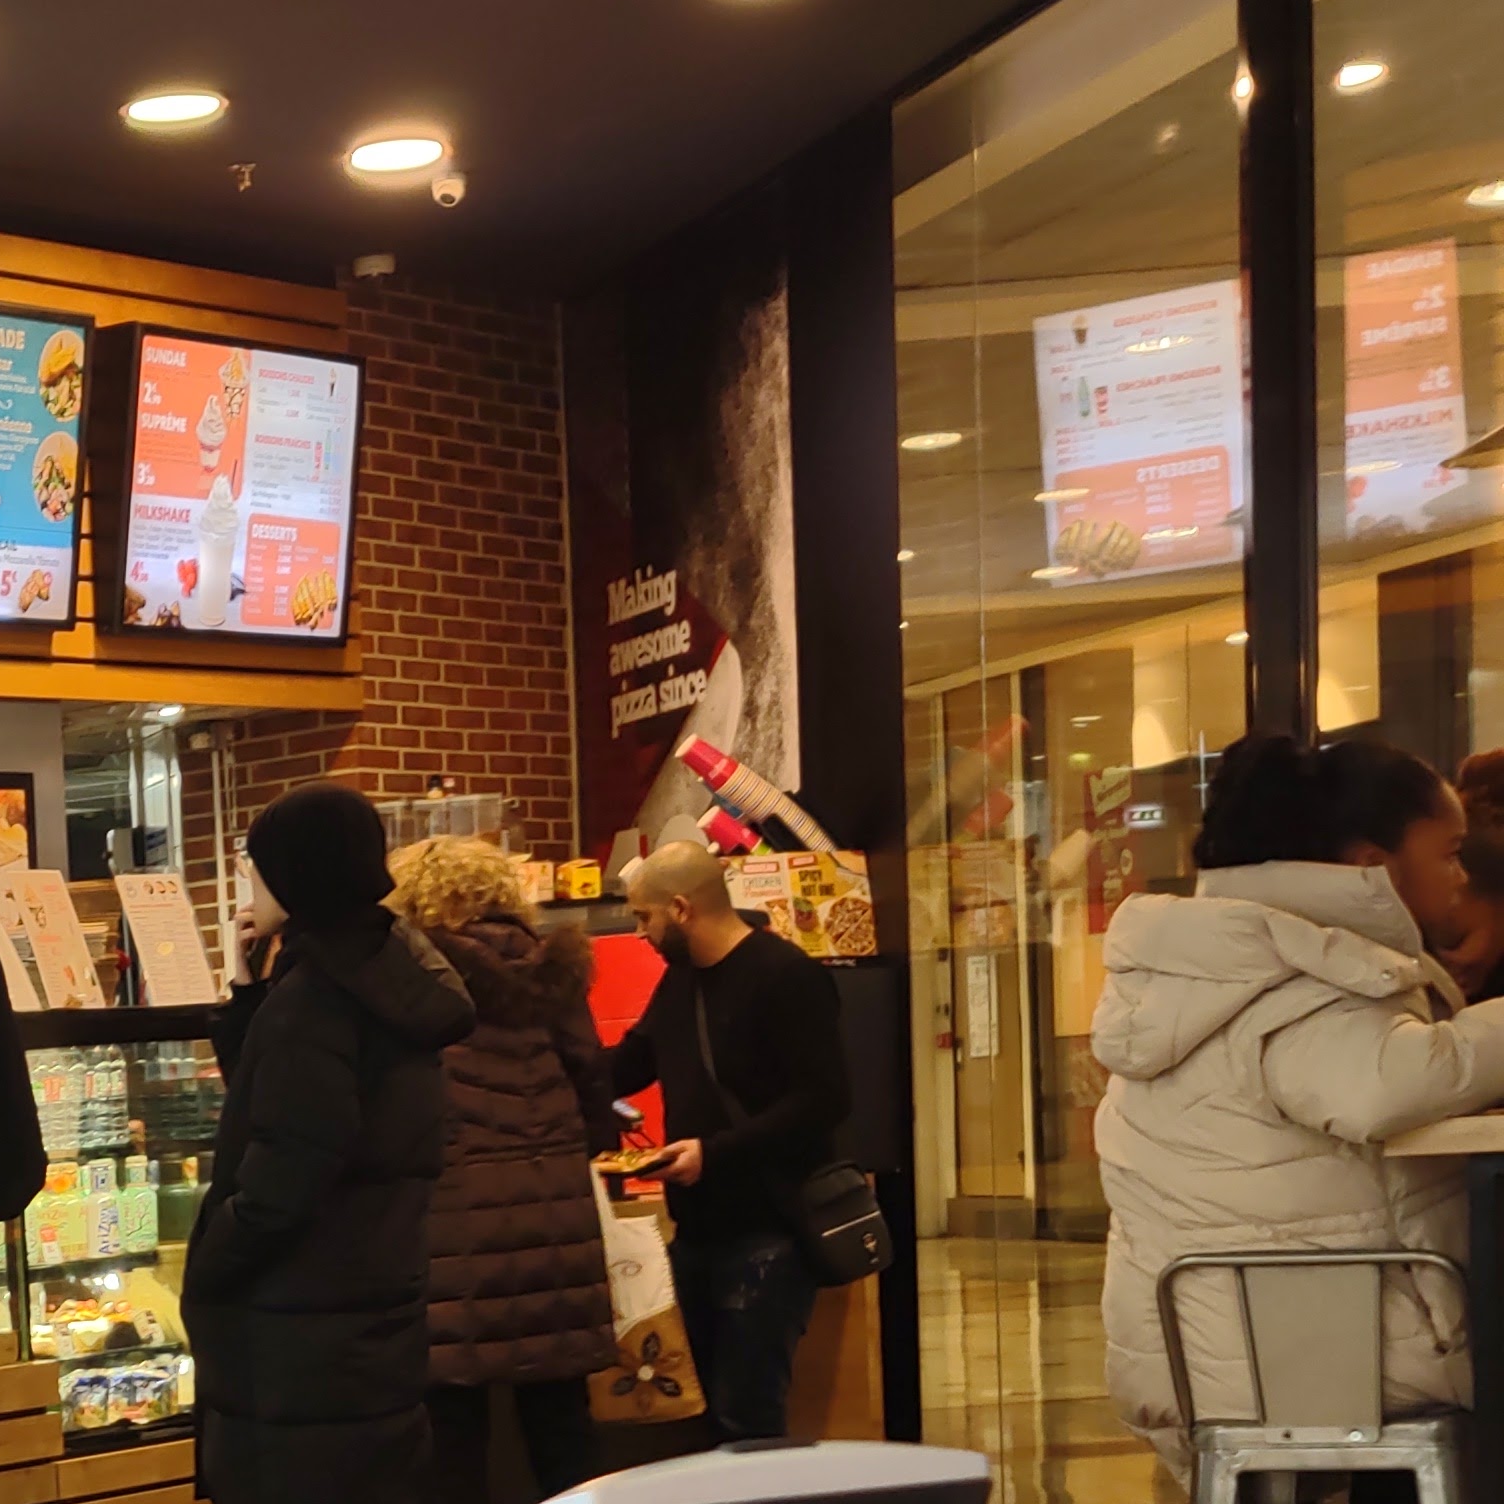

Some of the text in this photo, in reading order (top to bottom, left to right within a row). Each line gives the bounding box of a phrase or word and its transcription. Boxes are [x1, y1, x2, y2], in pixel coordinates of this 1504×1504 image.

[145, 347, 187, 368] SUNDAE
[141, 411, 188, 434] SUPRÊME
[134, 503, 191, 523] MILKSHAKE
[252, 524, 298, 542] DESSERTS
[607, 564, 677, 626] Making
[609, 619, 691, 677] awesome
[610, 663, 708, 739] pizza since
